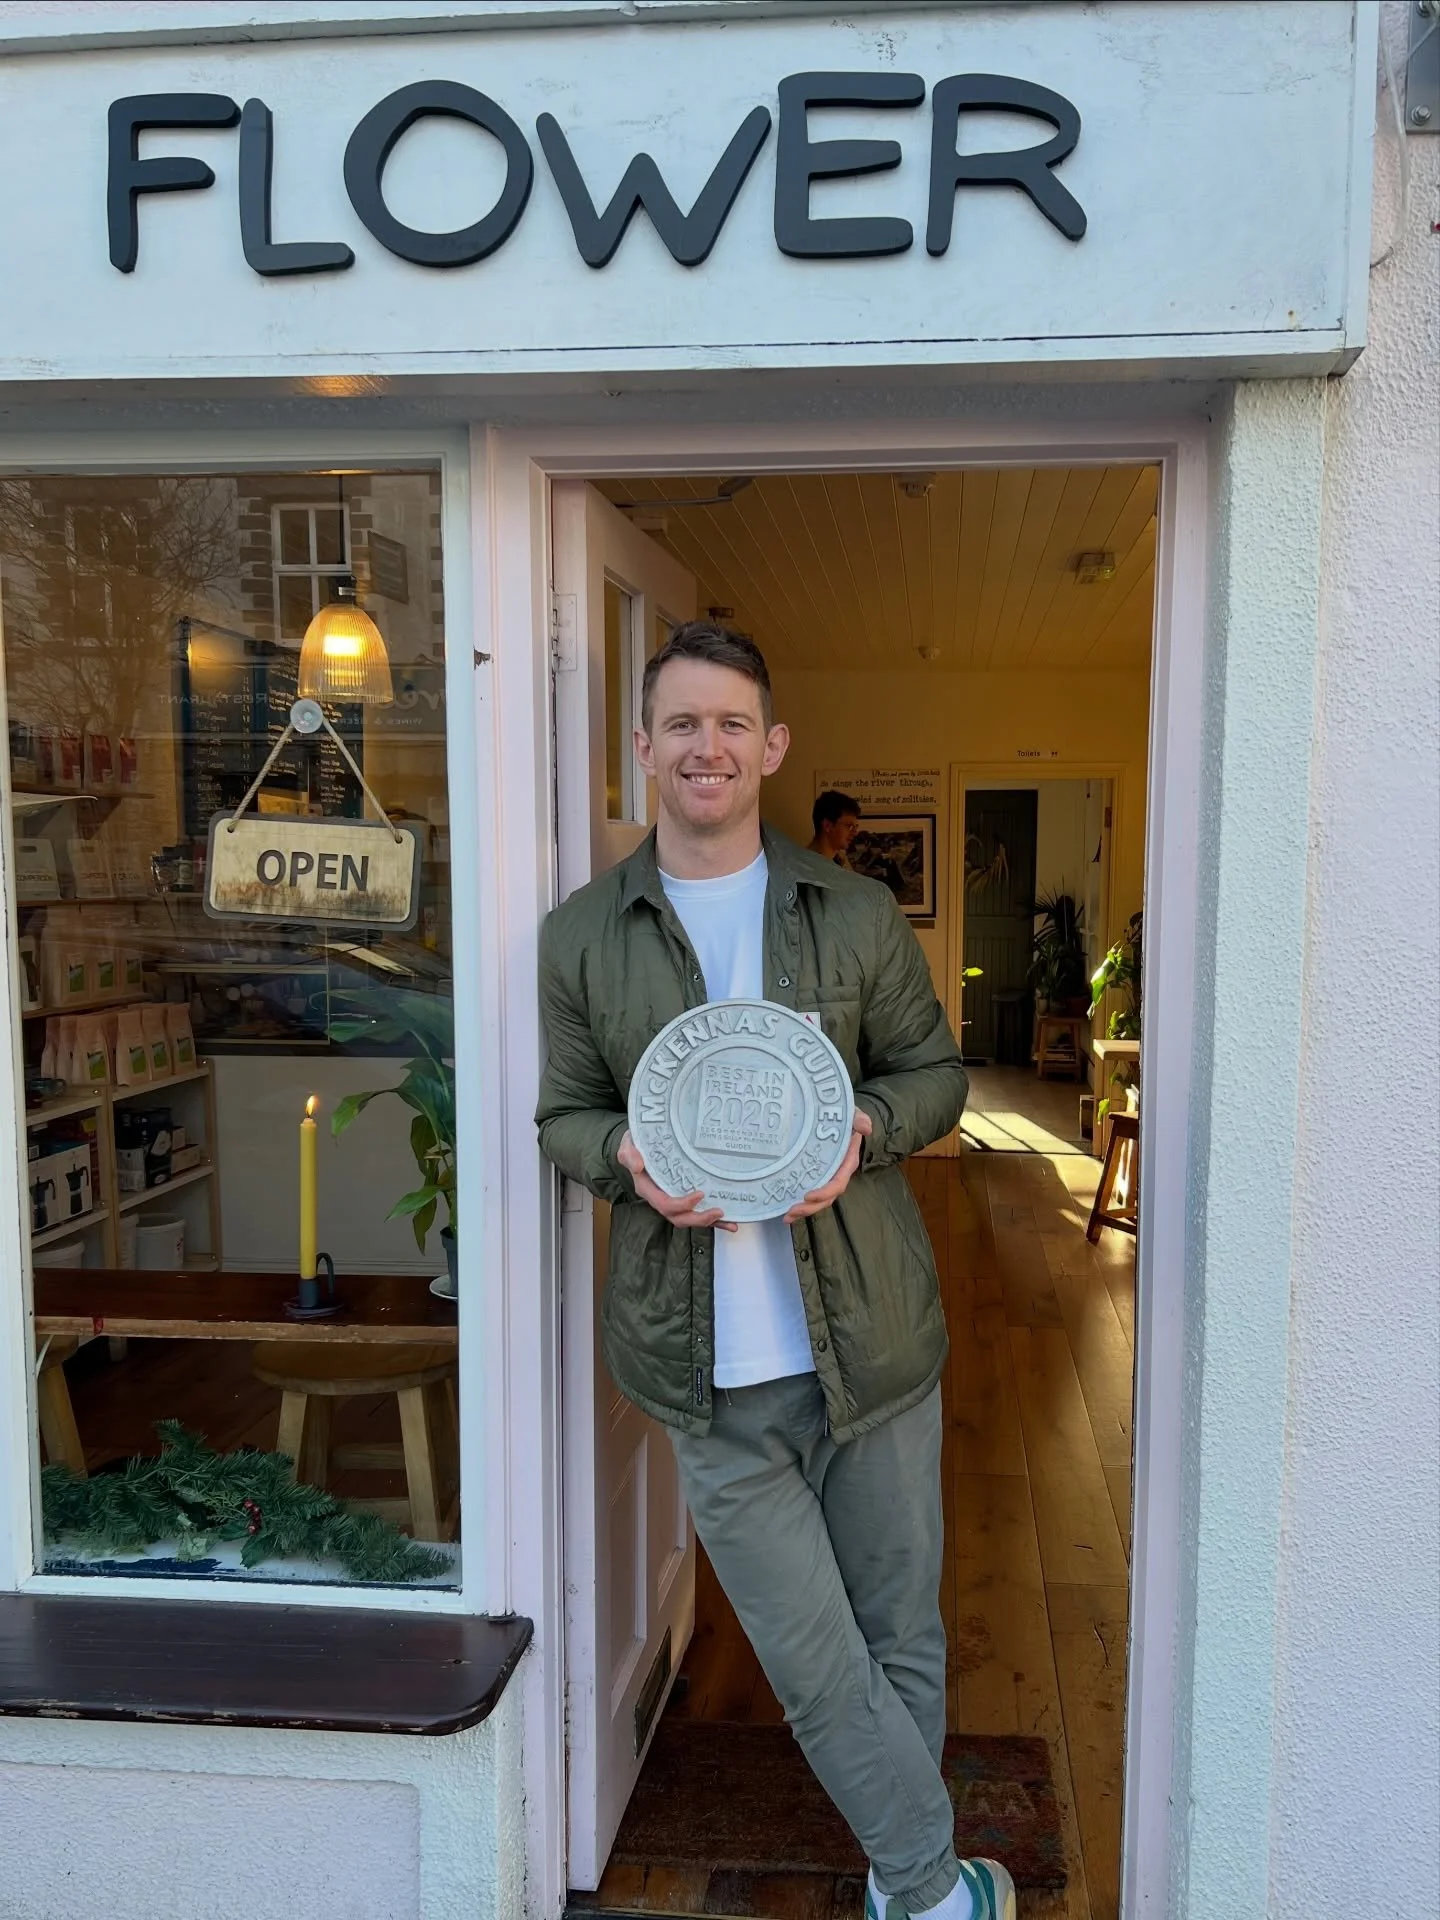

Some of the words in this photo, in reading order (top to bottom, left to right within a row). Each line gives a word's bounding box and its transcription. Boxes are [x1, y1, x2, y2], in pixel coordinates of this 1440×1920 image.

[107, 71, 1090, 277] FLOWER
[856, 778, 869, 787] the
[871, 778, 896, 787] river
[892, 795, 901, 804] of
[256, 849, 370, 893] OPEN
[707, 1064, 758, 1081] BEST
[765, 1071, 785, 1086] IN
[705, 1079, 783, 1099] IRELAND
[788, 1031, 844, 1145] GUIDES
[702, 1095, 783, 1132] 2026
[725, 1142, 752, 1150] GUIDES
